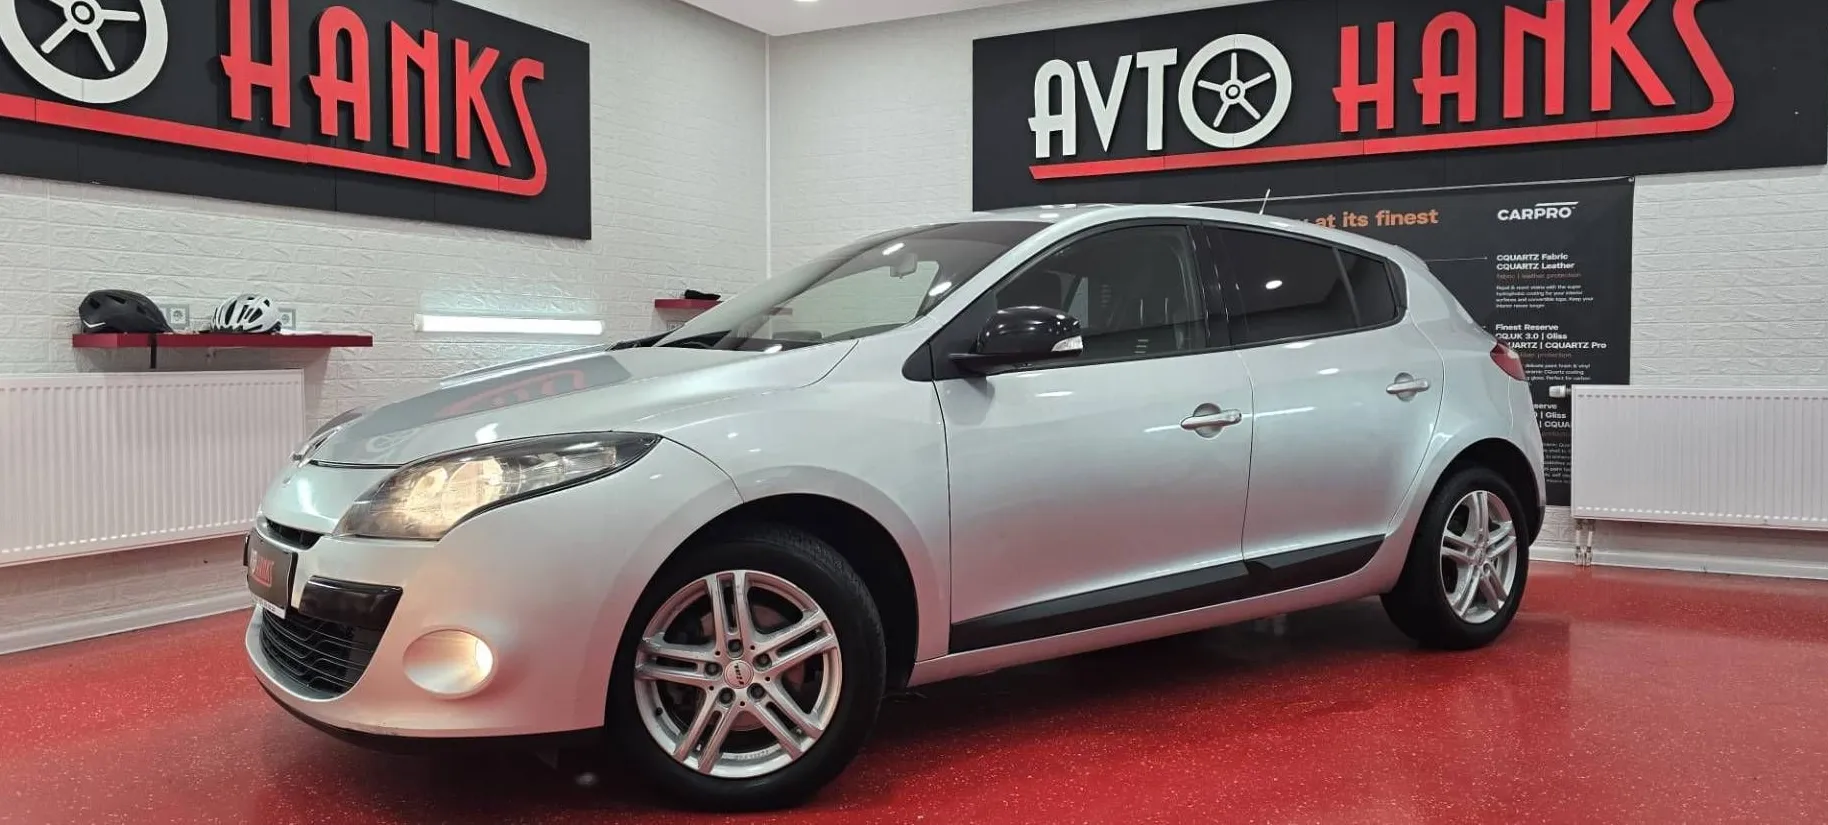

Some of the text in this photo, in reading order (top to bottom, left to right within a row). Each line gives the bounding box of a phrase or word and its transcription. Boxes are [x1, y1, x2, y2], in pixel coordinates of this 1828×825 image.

[1029, 0, 1735, 158] AVTO HANKS
[220, 0, 548, 197] HANKS
[1497, 206, 1573, 221] CARPRO
[1315, 209, 1439, 228] at its finest
[1496, 252, 1569, 262] CQUARTZ Fabric
[1496, 262, 1576, 271] CQUARTZ Leather
[1495, 323, 1559, 331] Finest Reserve
[1508, 341, 1538, 349] UARTZ
[1545, 341, 1590, 350] CQUARTZ
[1591, 341, 1607, 349] Pro
[1545, 411, 1567, 419] Gliss
[1544, 420, 1570, 429] CQUA
